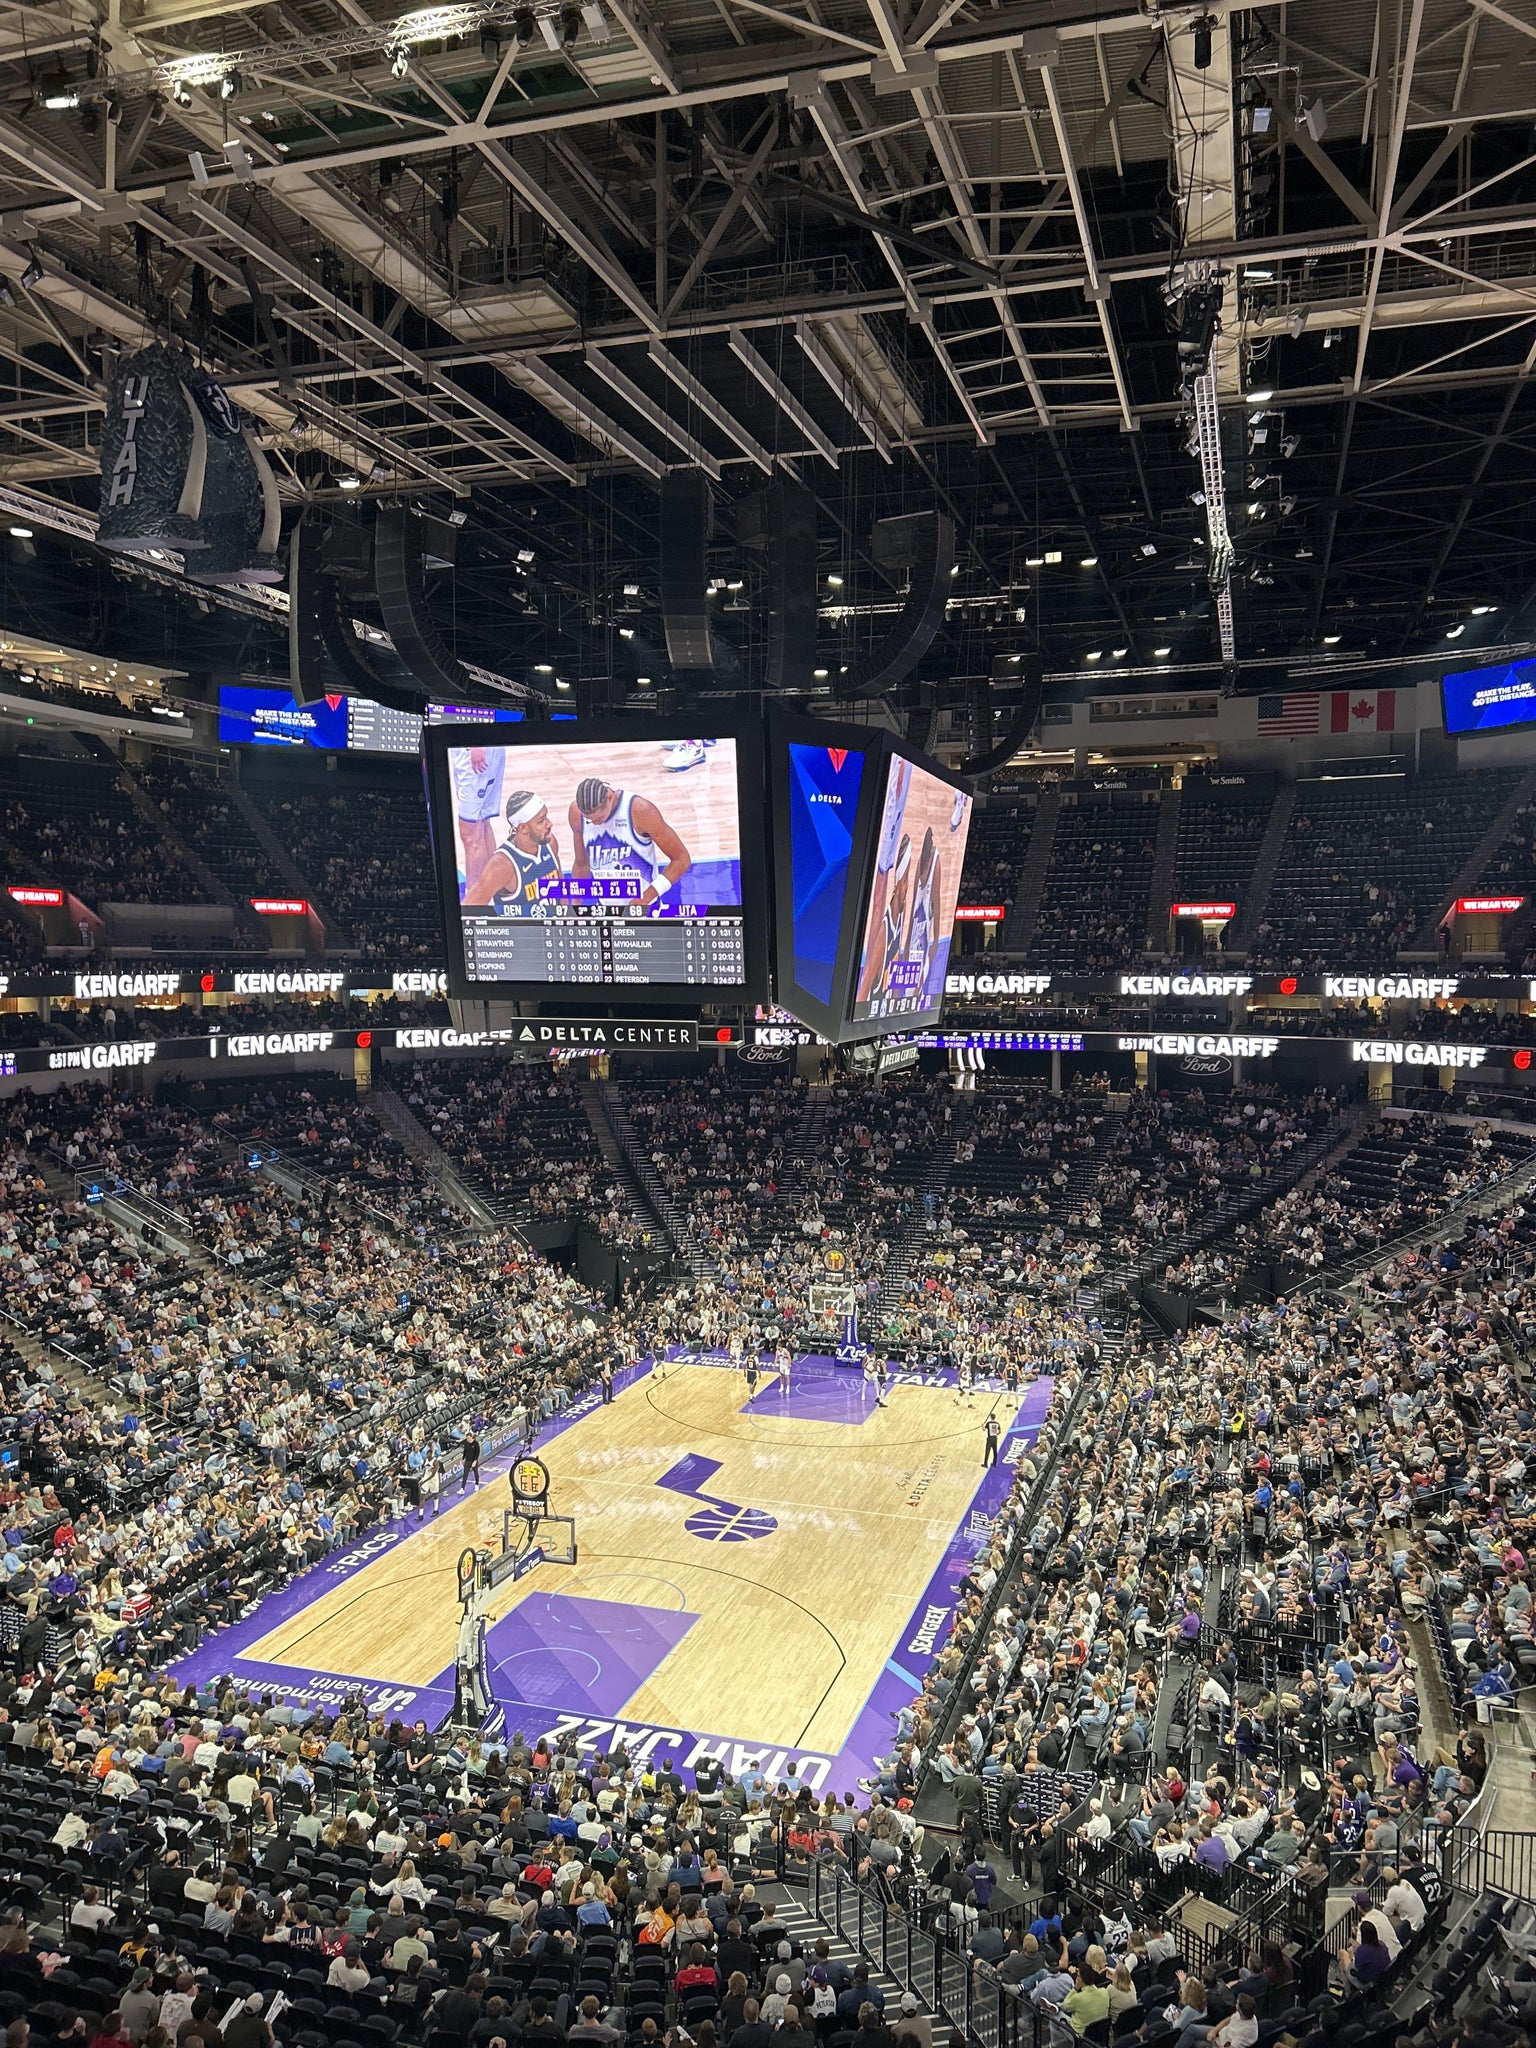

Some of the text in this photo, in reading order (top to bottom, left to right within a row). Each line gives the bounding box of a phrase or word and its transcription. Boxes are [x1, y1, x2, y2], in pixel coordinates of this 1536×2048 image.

[108, 376, 150, 506] UTAH
[1476, 688, 1497, 698] MAKE
[1498, 686, 1511, 695] THE
[1485, 696, 1499, 704] THE
[818, 794, 842, 804] DELTA
[589, 845, 632, 870] UTAH
[504, 906, 521, 915] DEN
[556, 906, 568, 916] 87
[591, 906, 606, 916] 3:57
[629, 906, 642, 916] 68
[679, 905, 697, 916] UTA
[945, 975, 1051, 994] EN GARFF
[1120, 976, 1252, 996] KEN GARFF
[1325, 977, 1458, 999] KEN GARFF
[540, 1026, 690, 1044] DELTA CENTER
[747, 1045, 783, 1061] Ford
[1196, 1037, 1279, 1057] GARFF
[1352, 1042, 1486, 1068] KEN GARFF
[884, 1051, 901, 1067] DELTA
[1180, 1055, 1220, 1072] Ford
[569, 1394, 603, 1415] PACS
[491, 1427, 520, 1450] First Colony
[439, 1464, 452, 1483] First
[910, 1454, 946, 1502] DELTA CENTER
[337, 1533, 399, 1566] PACS
[908, 1604, 951, 1655] SEATGEEK
[1425, 1882, 1443, 1902] 22
